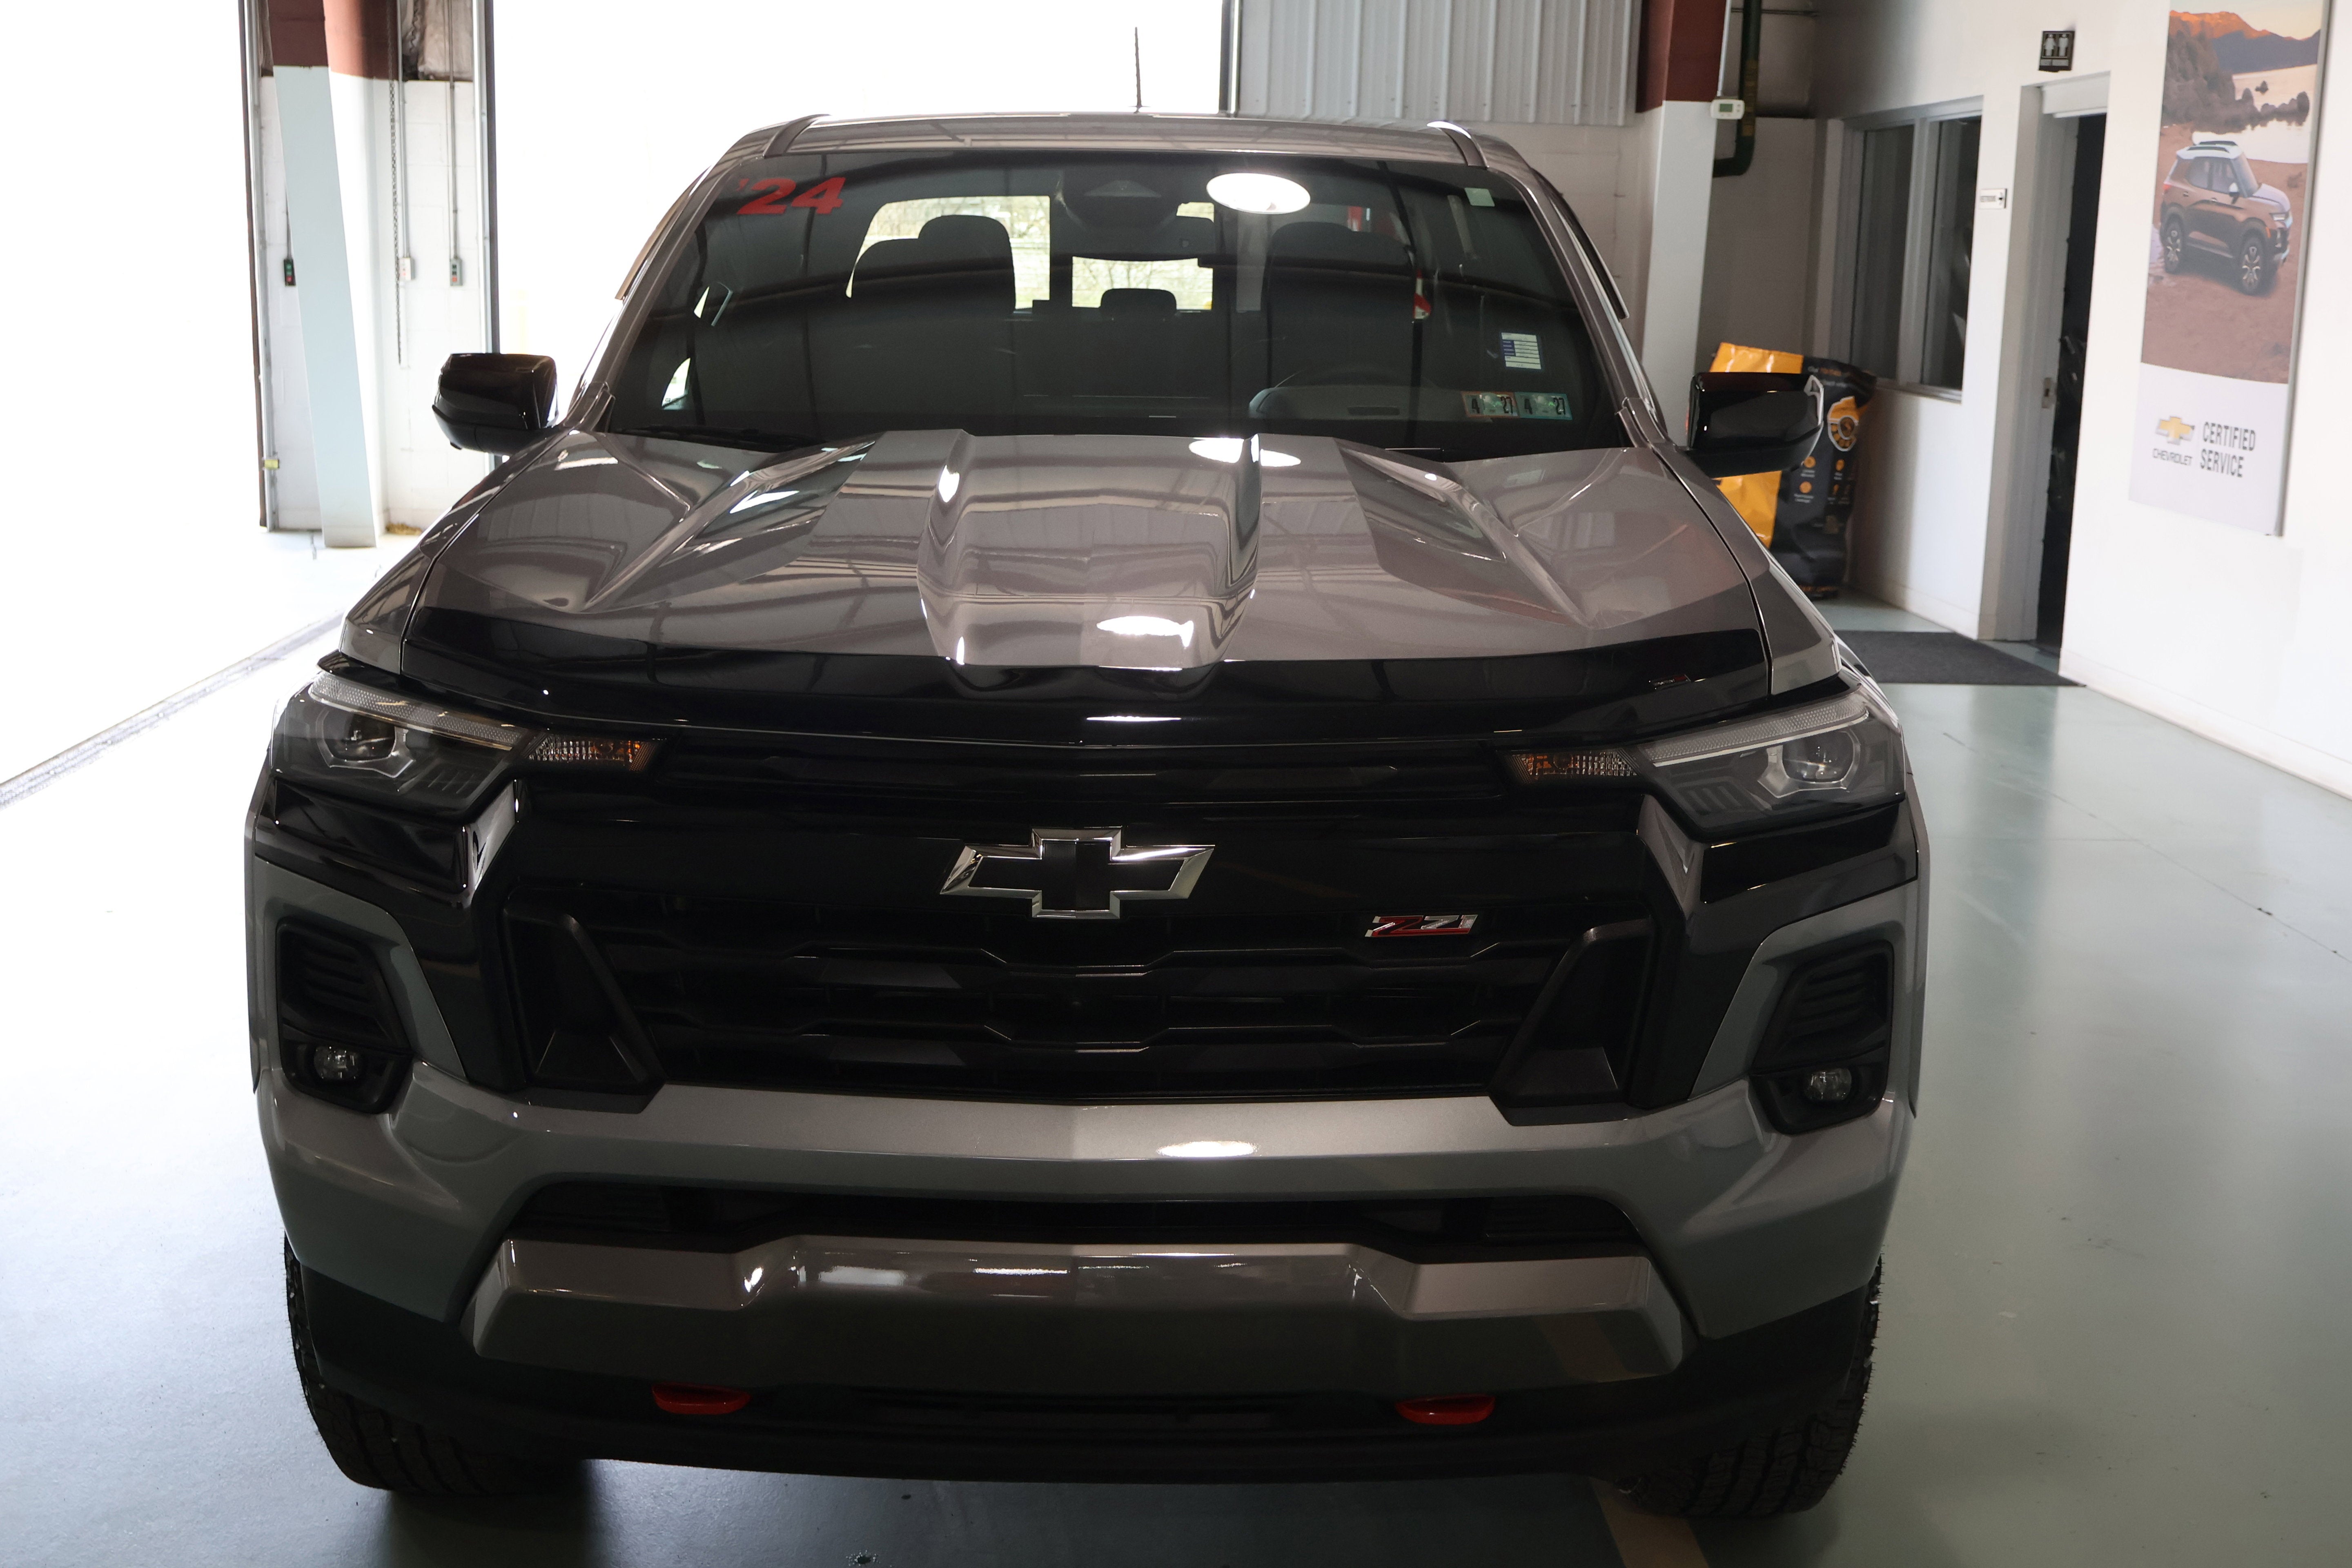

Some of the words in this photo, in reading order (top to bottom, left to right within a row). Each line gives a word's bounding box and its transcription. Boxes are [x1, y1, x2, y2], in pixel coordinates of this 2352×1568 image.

[736, 177, 846, 215] '24
[1472, 399, 1480, 414] 4
[1500, 396, 1513, 414] 27
[1524, 399, 1533, 414] 4
[1554, 397, 1566, 415] 27
[2203, 421, 2256, 451] CERTIFIED
[2153, 448, 2192, 466] CHEVROLET
[2200, 449, 2244, 478] SERVICE
[1364, 914, 1479, 938] Z71
